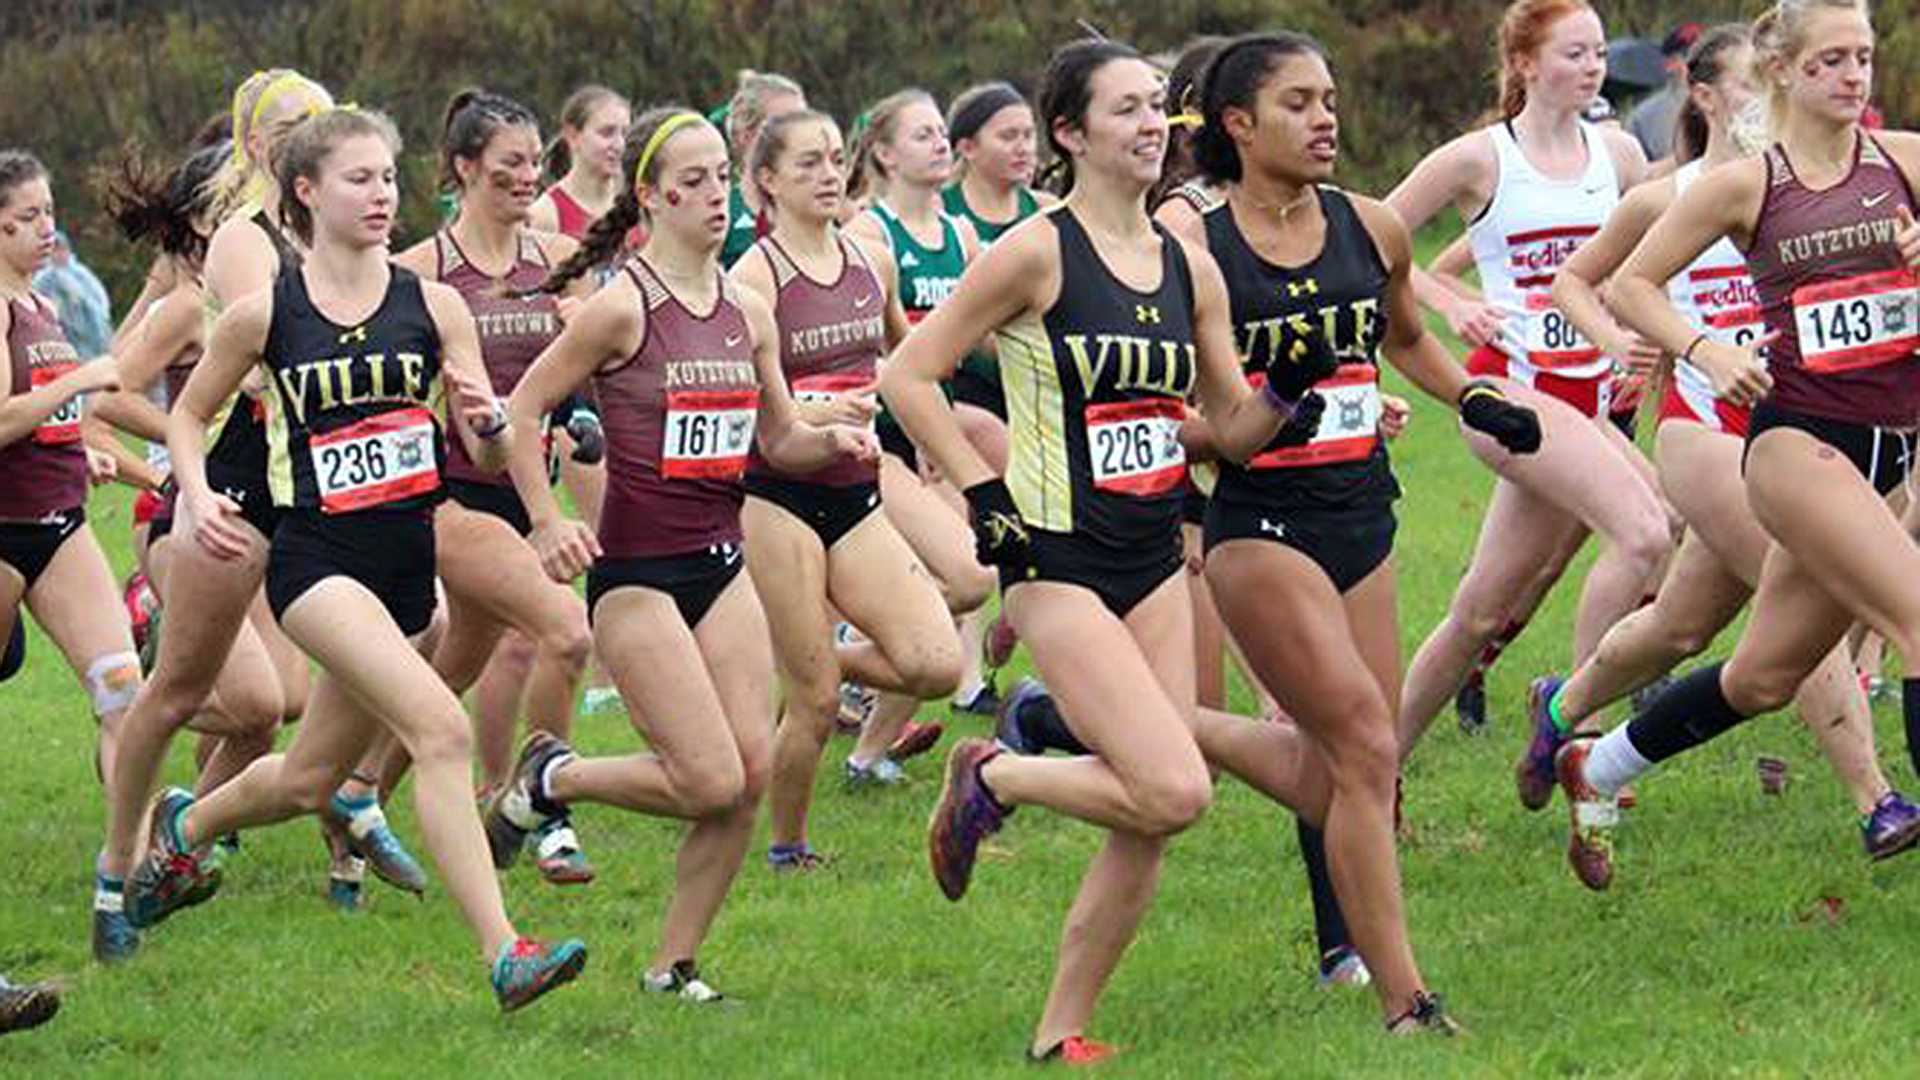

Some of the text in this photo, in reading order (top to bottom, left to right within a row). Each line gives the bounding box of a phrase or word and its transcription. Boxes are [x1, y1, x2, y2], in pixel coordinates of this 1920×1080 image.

[1808, 300, 1872, 349] 143
[279, 353, 425, 425] VILLE
[676, 414, 723, 455] 161
[1097, 423, 1153, 474] 226
[322, 439, 386, 489] 236
